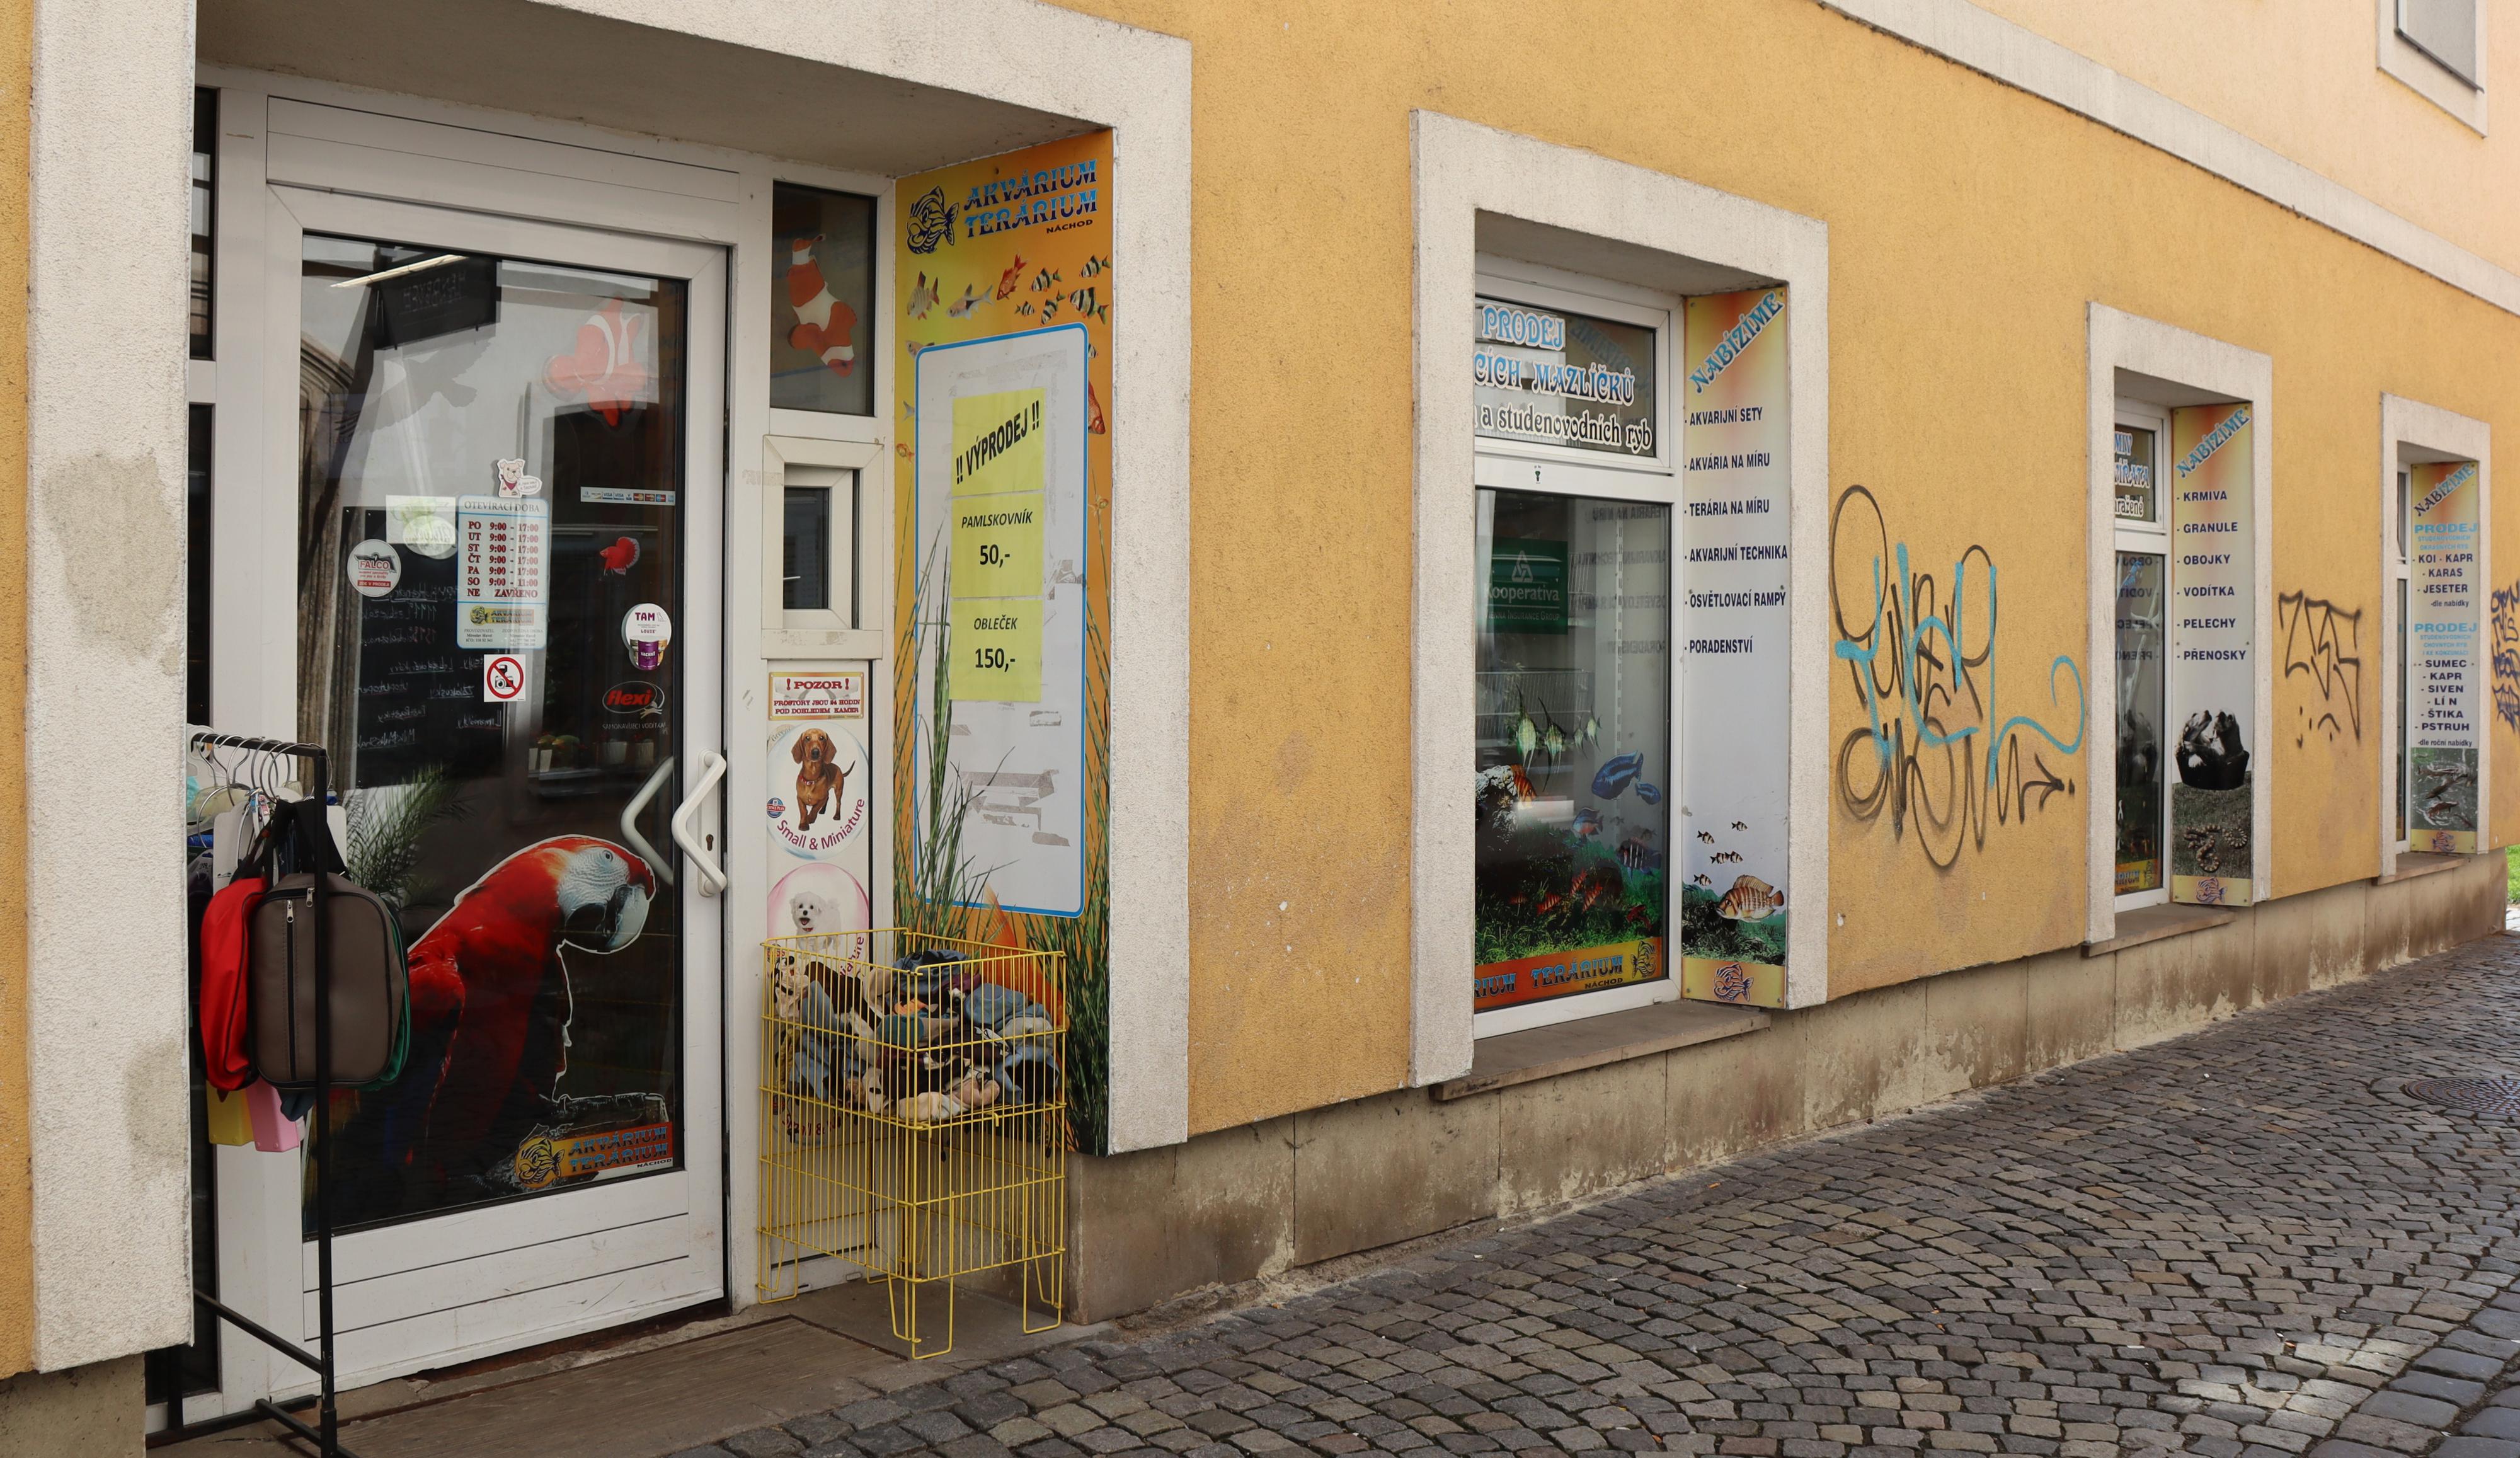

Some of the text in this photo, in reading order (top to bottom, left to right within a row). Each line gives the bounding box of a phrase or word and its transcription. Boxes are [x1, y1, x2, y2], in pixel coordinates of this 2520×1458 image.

[963, 159, 1098, 211] AKVÁRIUM
[963, 189, 1098, 239] TERÁRIUM
[1046, 219, 1093, 234] NÁCHOD
[1482, 305, 1565, 350] PRODEJ
[1689, 292, 1784, 394] NABÍZÍME
[1532, 363, 1634, 405] MAZLÍČKŮ
[1690, 405, 1763, 426] AKVARIJNÍ SETY
[1482, 403, 1652, 453] a studenovodních ryb
[966, 408, 1028, 476] VÝPRODEJ
[2176, 409, 2250, 478] NABÍZÍME
[1689, 450, 1770, 471] AKVÁRIA NA MÍRU
[2414, 463, 2475, 517] NABÍZÍME
[2184, 491, 2227, 502] KRMIVA
[464, 500, 539, 512] OTEVÍRACÍ DOBA
[1690, 497, 1770, 517] TERÁRIA NA MÍRU
[961, 508, 1033, 528] PAMLSKOVNÍK
[468, 521, 481, 529] PO
[490, 522, 507, 531] 9:00
[518, 524, 539, 532] 17:00
[2184, 522, 2238, 533] GRANULE
[2414, 523, 2478, 534] PRODEJ
[490, 533, 507, 541] 9:00
[518, 534, 539, 542] 17:00
[468, 544, 479, 552] ST
[490, 544, 507, 553] 9:00
[518, 546, 539, 554] 17:00
[1690, 543, 1788, 562] AKVARIJNÍ TECHNIKA
[468, 553, 481, 563] ČT
[489, 556, 507, 564] 9:00
[518, 556, 539, 565] 17:00
[980, 544, 1010, 568] 50,-
[2184, 554, 2230, 565] OBOJKY
[2419, 554, 2436, 563] KOI
[2446, 553, 2473, 563] KAPR
[359, 560, 389, 570] FALCO
[467, 566, 479, 574] PA
[489, 566, 506, 575] 9:00
[518, 567, 538, 576] 17:00
[2429, 568, 2463, 577] KARAS
[467, 577, 480, 585] SO
[489, 578, 506, 586] 9:00
[518, 578, 538, 587] 11:00
[467, 588, 480, 597] NE
[495, 587, 538, 598] ZAVŘENO
[2184, 584, 2235, 596] VODÍTKA
[2424, 584, 2468, 594] JESETER
[1690, 589, 1786, 608] OSVĚTLOVACÍ RAMPY
[635, 612, 655, 621] TAM
[973, 614, 1018, 630] OBLEČEK
[2184, 618, 2236, 628] PELECHY
[2414, 623, 2477, 633] PRODEJ
[1690, 635, 1753, 653] PORADENSTVÍ
[975, 648, 1016, 672] 150,-
[2184, 648, 2247, 660] PŘENOSKY
[794, 681, 842, 689] POZOR
[607, 689, 653, 706] flexi
[2428, 708, 2463, 718] ŠTIKA
[2422, 723, 2470, 731] PSTRUH
[777, 799, 864, 850] Small & Miniature
[1531, 955, 1624, 989] TERÁRIUM
[1584, 977, 1624, 989] NÁCHOD
[568, 1126, 668, 1156] AKVÁRIUM
[569, 1142, 668, 1173] TERÁRIUM
[636, 1158, 672, 1169] NÁCHOD
